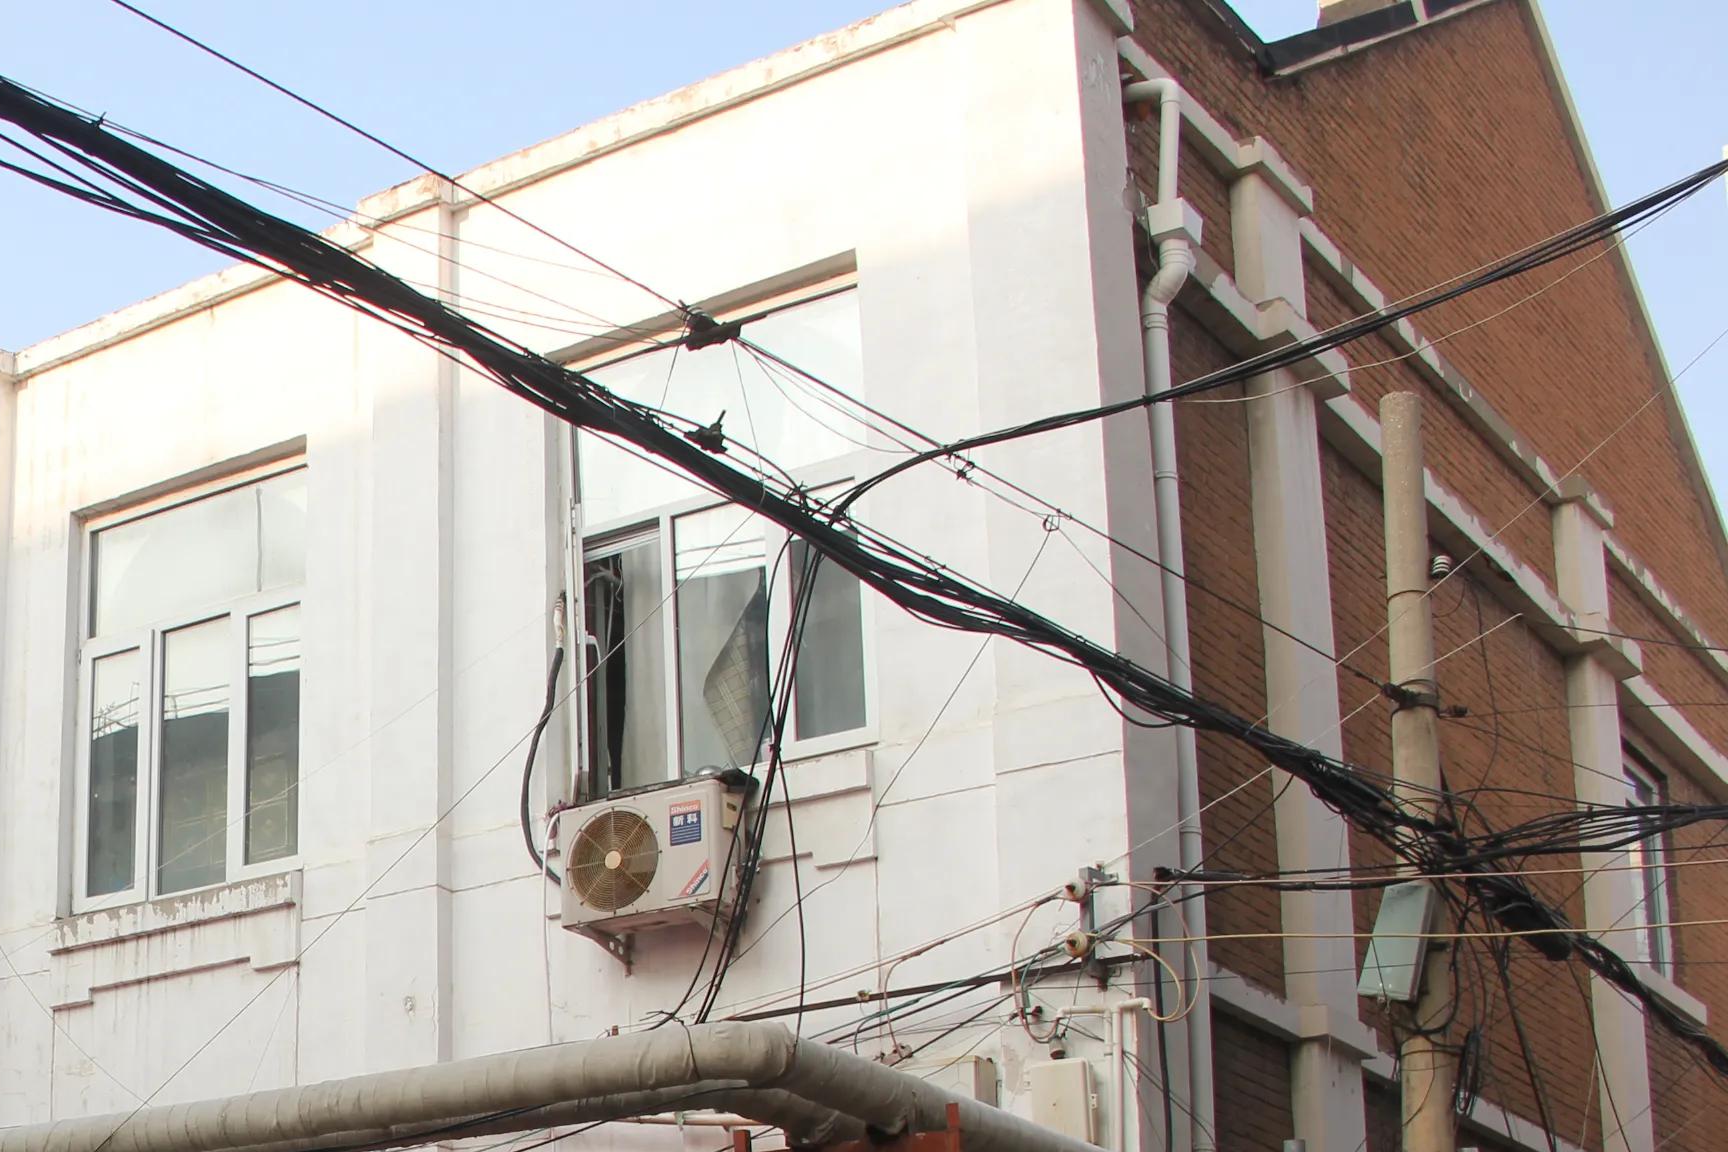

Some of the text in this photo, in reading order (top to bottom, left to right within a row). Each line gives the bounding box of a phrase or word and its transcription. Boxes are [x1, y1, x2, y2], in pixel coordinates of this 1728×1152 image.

[671, 804, 698, 815] Shinco
[672, 813, 698, 827] 新科
[686, 868, 708, 895] Shinco
